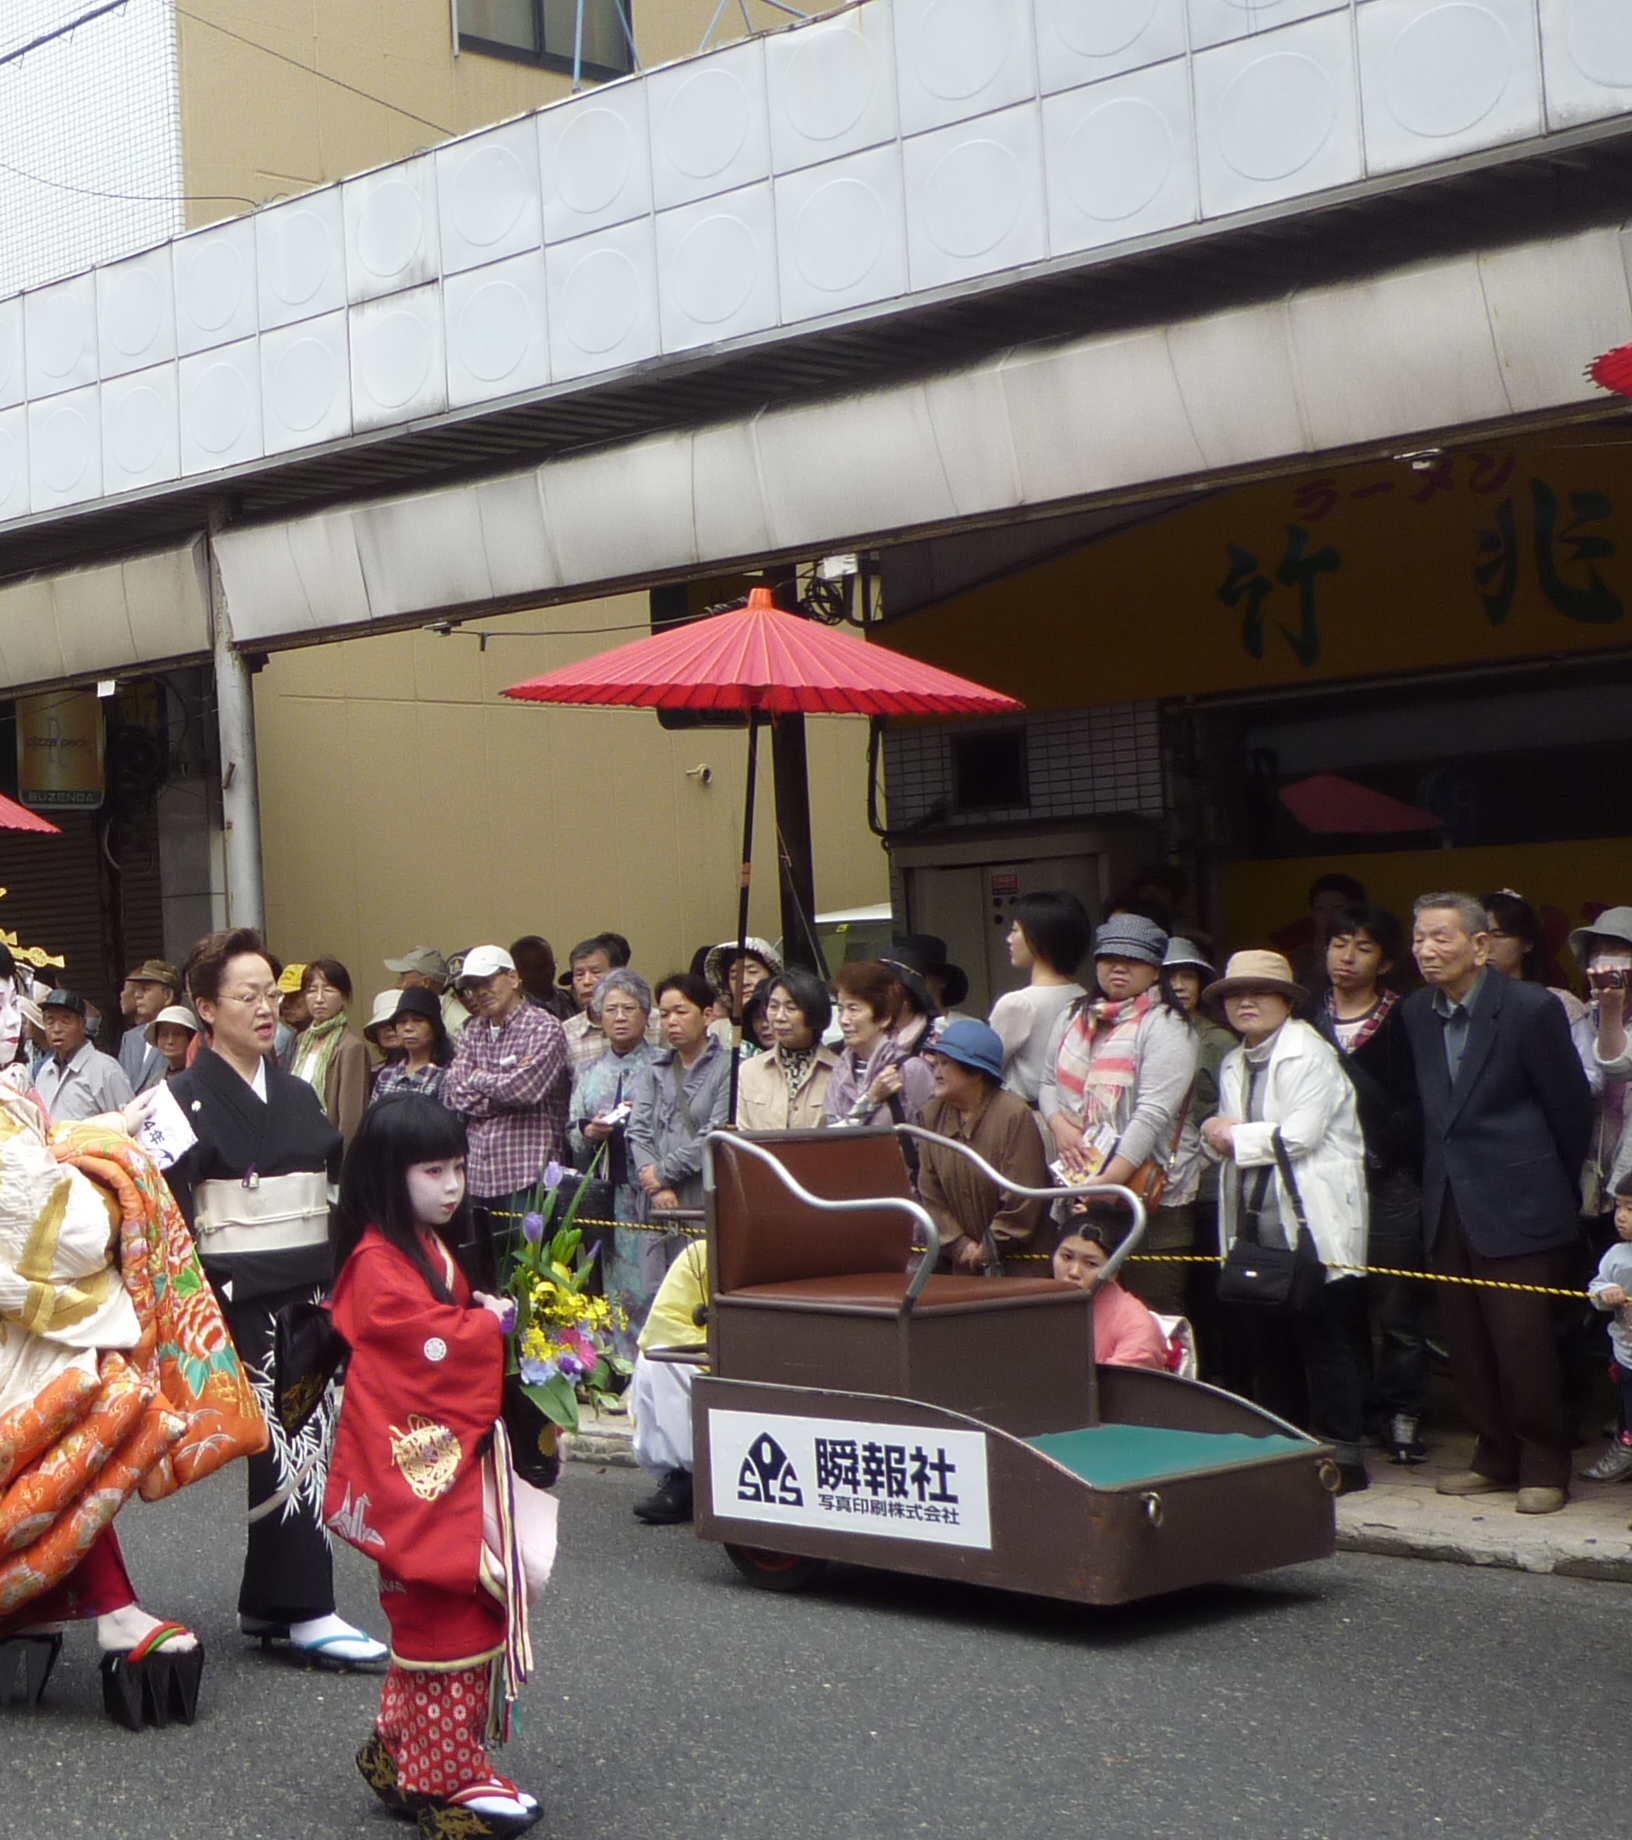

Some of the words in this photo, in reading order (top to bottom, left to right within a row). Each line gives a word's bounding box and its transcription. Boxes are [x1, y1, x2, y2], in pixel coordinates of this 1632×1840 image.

[1294, 453, 1515, 522] ラーメン
[28, 791, 95, 803] BUZENDA
[814, 1437, 959, 1505] 瞬報社
[817, 1493, 961, 1526] 写真印刷株式会社
